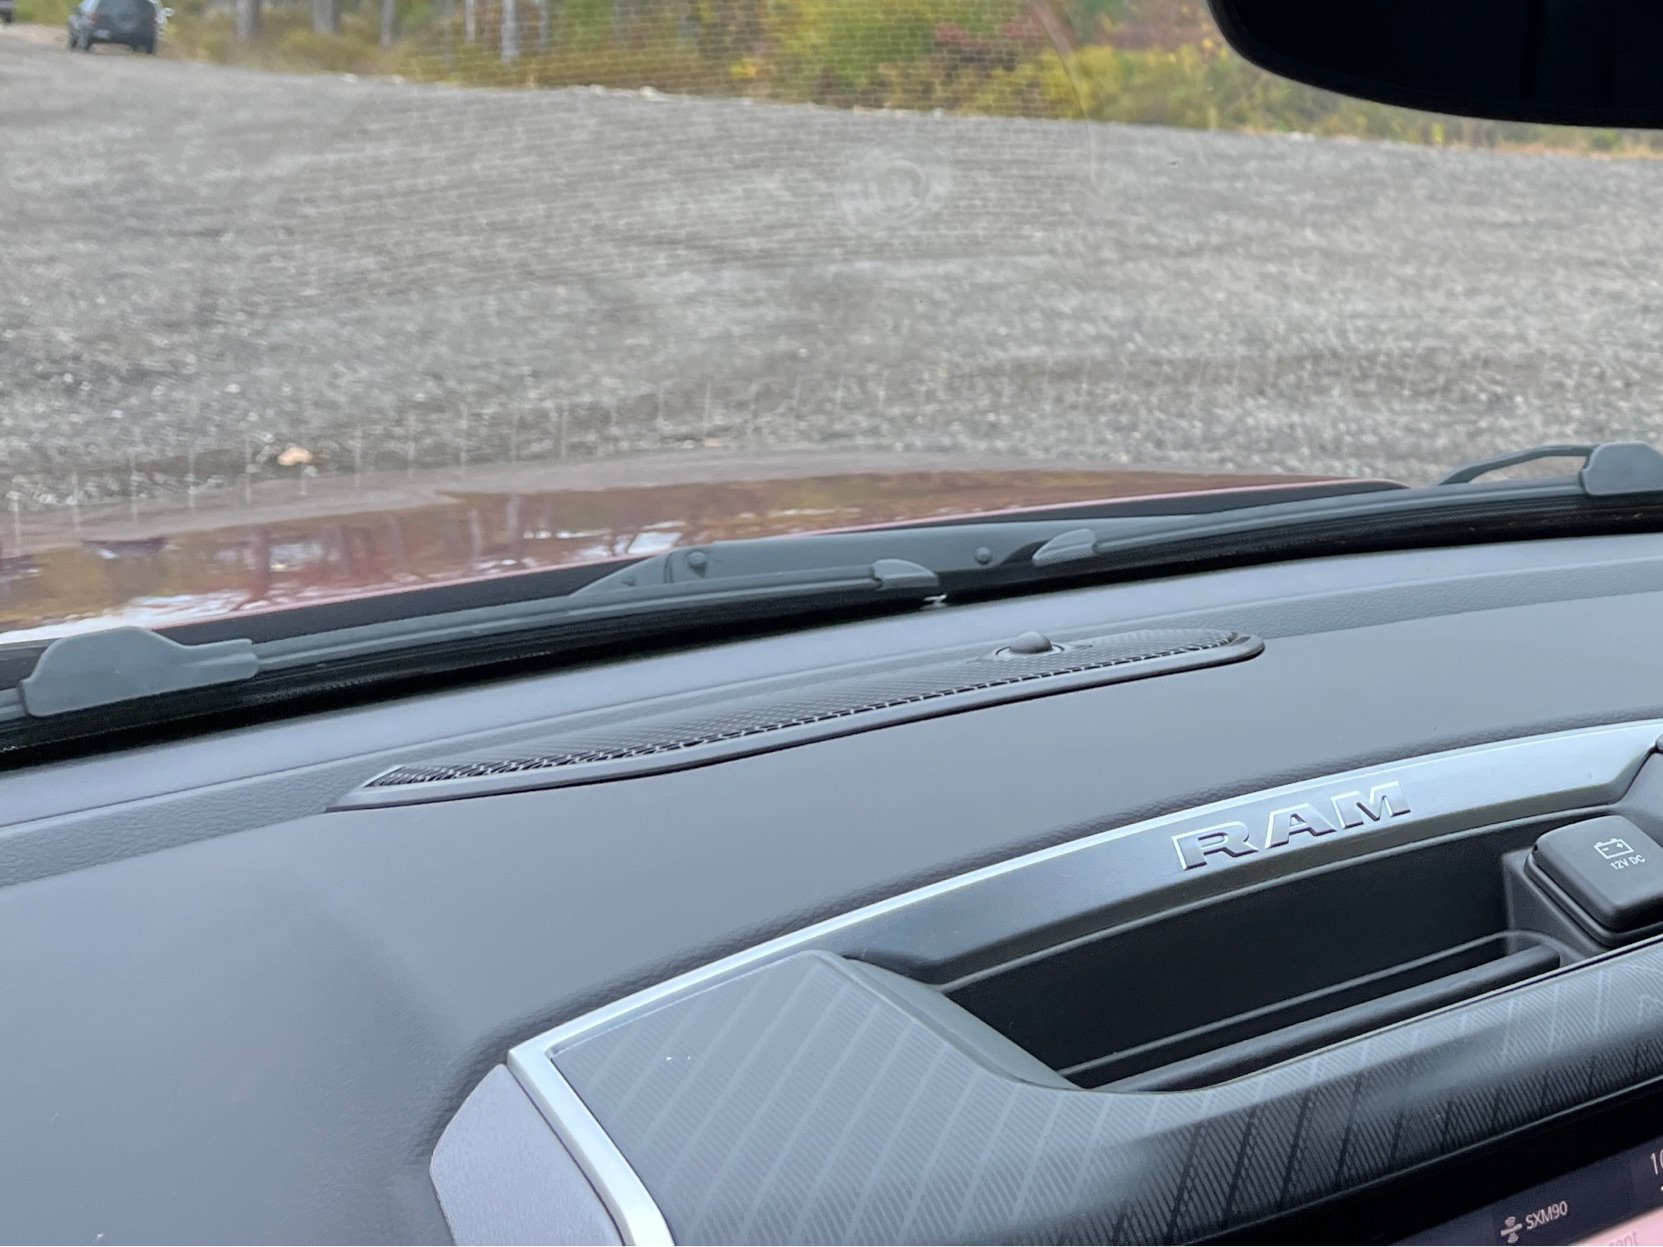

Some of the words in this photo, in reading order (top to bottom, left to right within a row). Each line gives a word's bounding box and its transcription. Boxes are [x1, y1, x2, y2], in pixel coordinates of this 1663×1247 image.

[1171, 780, 1411, 871] RAM
[1609, 858, 1629, 870] 12V
[1629, 854, 1646, 865] DC
[1525, 1200, 1568, 1231] SXM90
